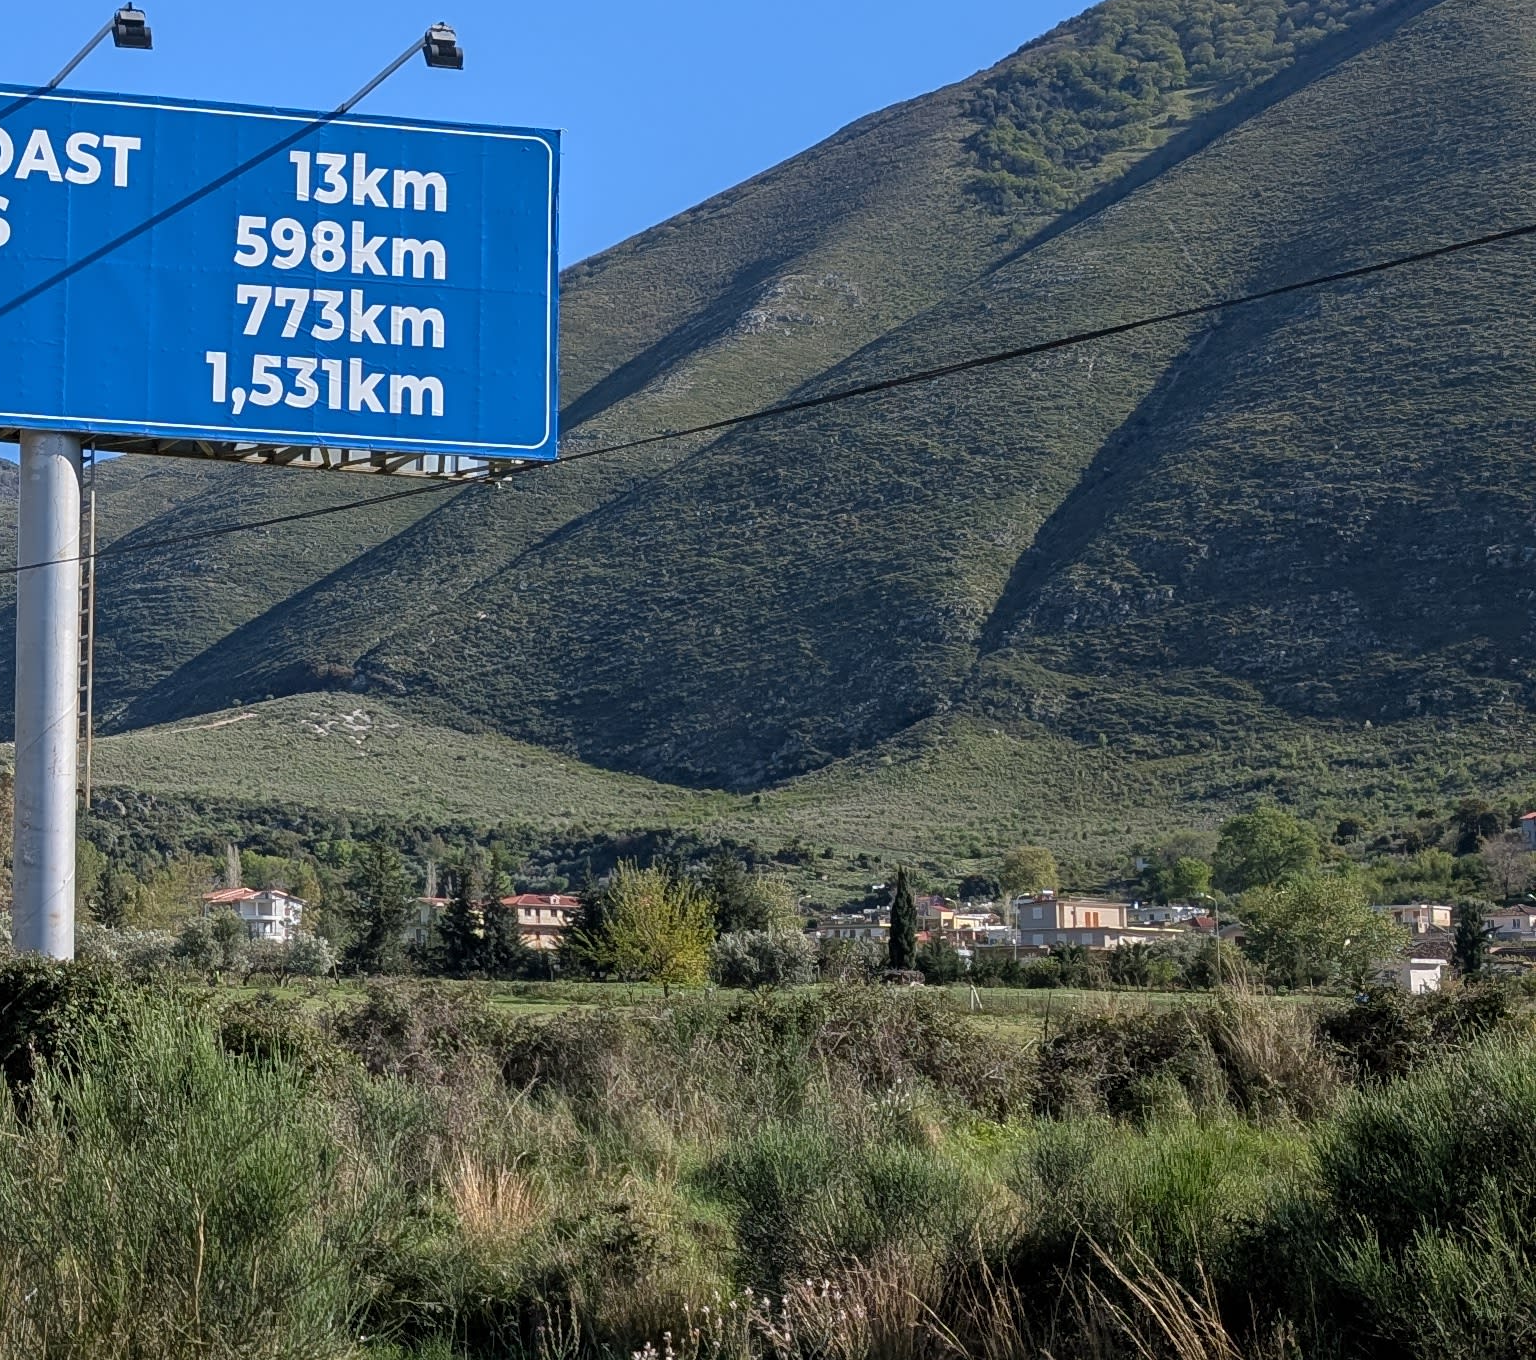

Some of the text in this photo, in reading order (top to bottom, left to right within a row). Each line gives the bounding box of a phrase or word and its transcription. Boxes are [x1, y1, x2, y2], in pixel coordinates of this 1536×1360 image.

[290, 150, 448, 213] 13km
[233, 215, 446, 280] 598km
[236, 283, 445, 349] 773km
[205, 351, 444, 417] 1,531km
